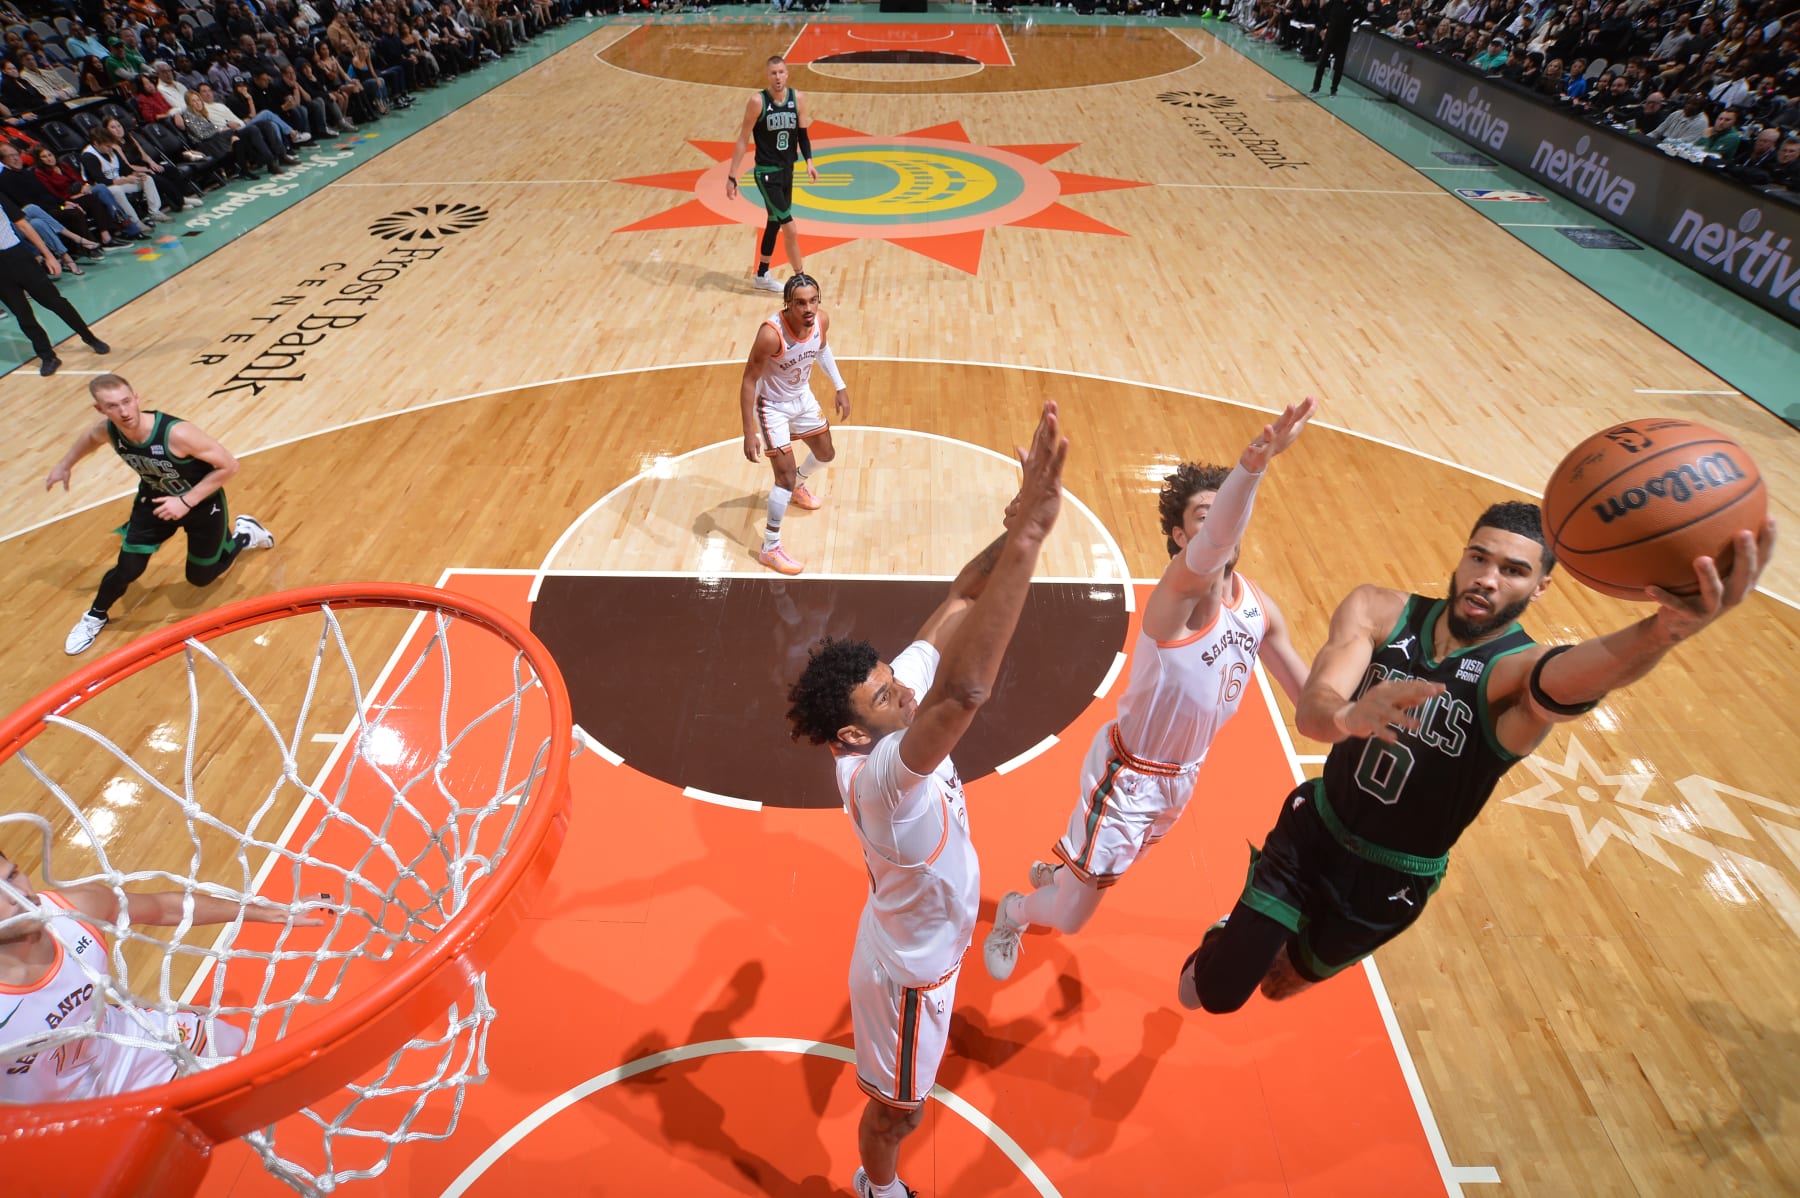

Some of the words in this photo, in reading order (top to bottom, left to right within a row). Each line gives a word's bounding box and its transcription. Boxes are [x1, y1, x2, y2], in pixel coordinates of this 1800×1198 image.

[1366, 53, 1421, 105] nextiva
[766, 111, 797, 132] CELTICS
[776, 131, 790, 151] 8
[1182, 116, 1236, 158] CENTER
[1209, 111, 1263, 136] Frost
[1238, 139, 1310, 170] Bank
[1435, 88, 1509, 150] nextiva
[1529, 135, 1637, 217] nextiva
[185, 182, 300, 229] Spurs
[323, 246, 444, 306] Frost
[190, 262, 347, 365] CENTER
[208, 313, 367, 398] Bank
[1591, 451, 1745, 524] Wilson
[1242, 607, 1261, 619] Self.
[1216, 662, 1248, 706] 16
[1455, 669, 1480, 684] PRINT
[1460, 658, 1485, 673] VISTA
[1357, 663, 1473, 758] CICS
[1354, 735, 1416, 805] 0
[70, 935, 93, 960] elf.
